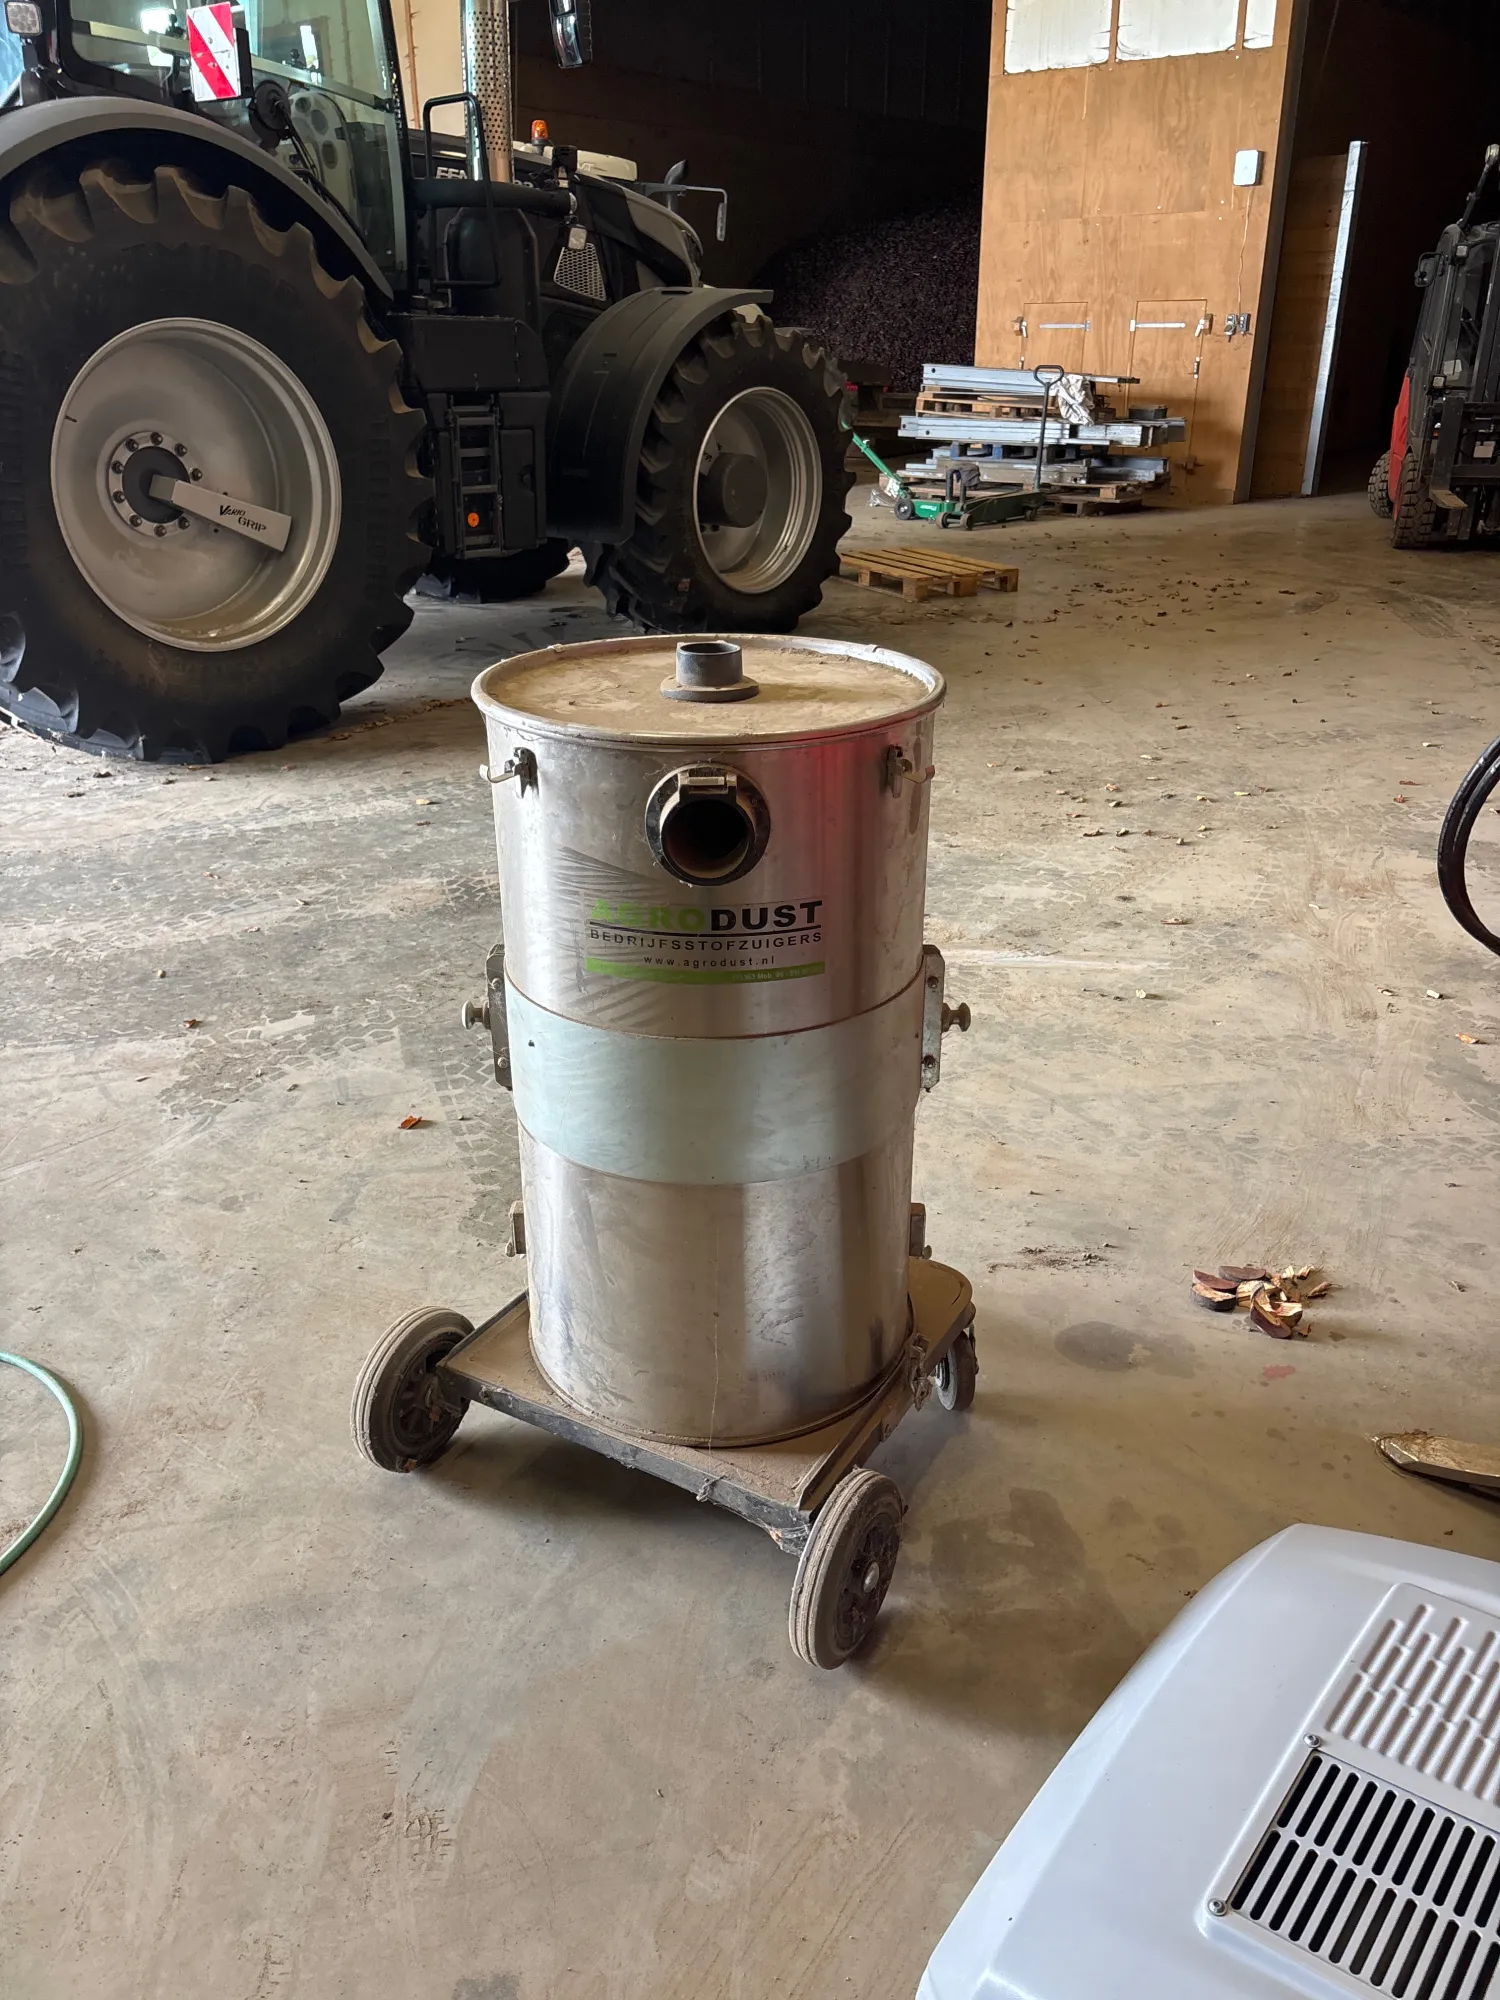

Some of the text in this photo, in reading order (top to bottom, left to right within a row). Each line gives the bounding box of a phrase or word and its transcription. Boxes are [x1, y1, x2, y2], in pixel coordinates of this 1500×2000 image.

[237, 516, 267, 532] GRIP
[591, 898, 823, 932] AGRODUST
[590, 929, 822, 950] BEDRIJFSSTOFZUIGERS
[643, 955, 775, 969] www.agrodust.nl
